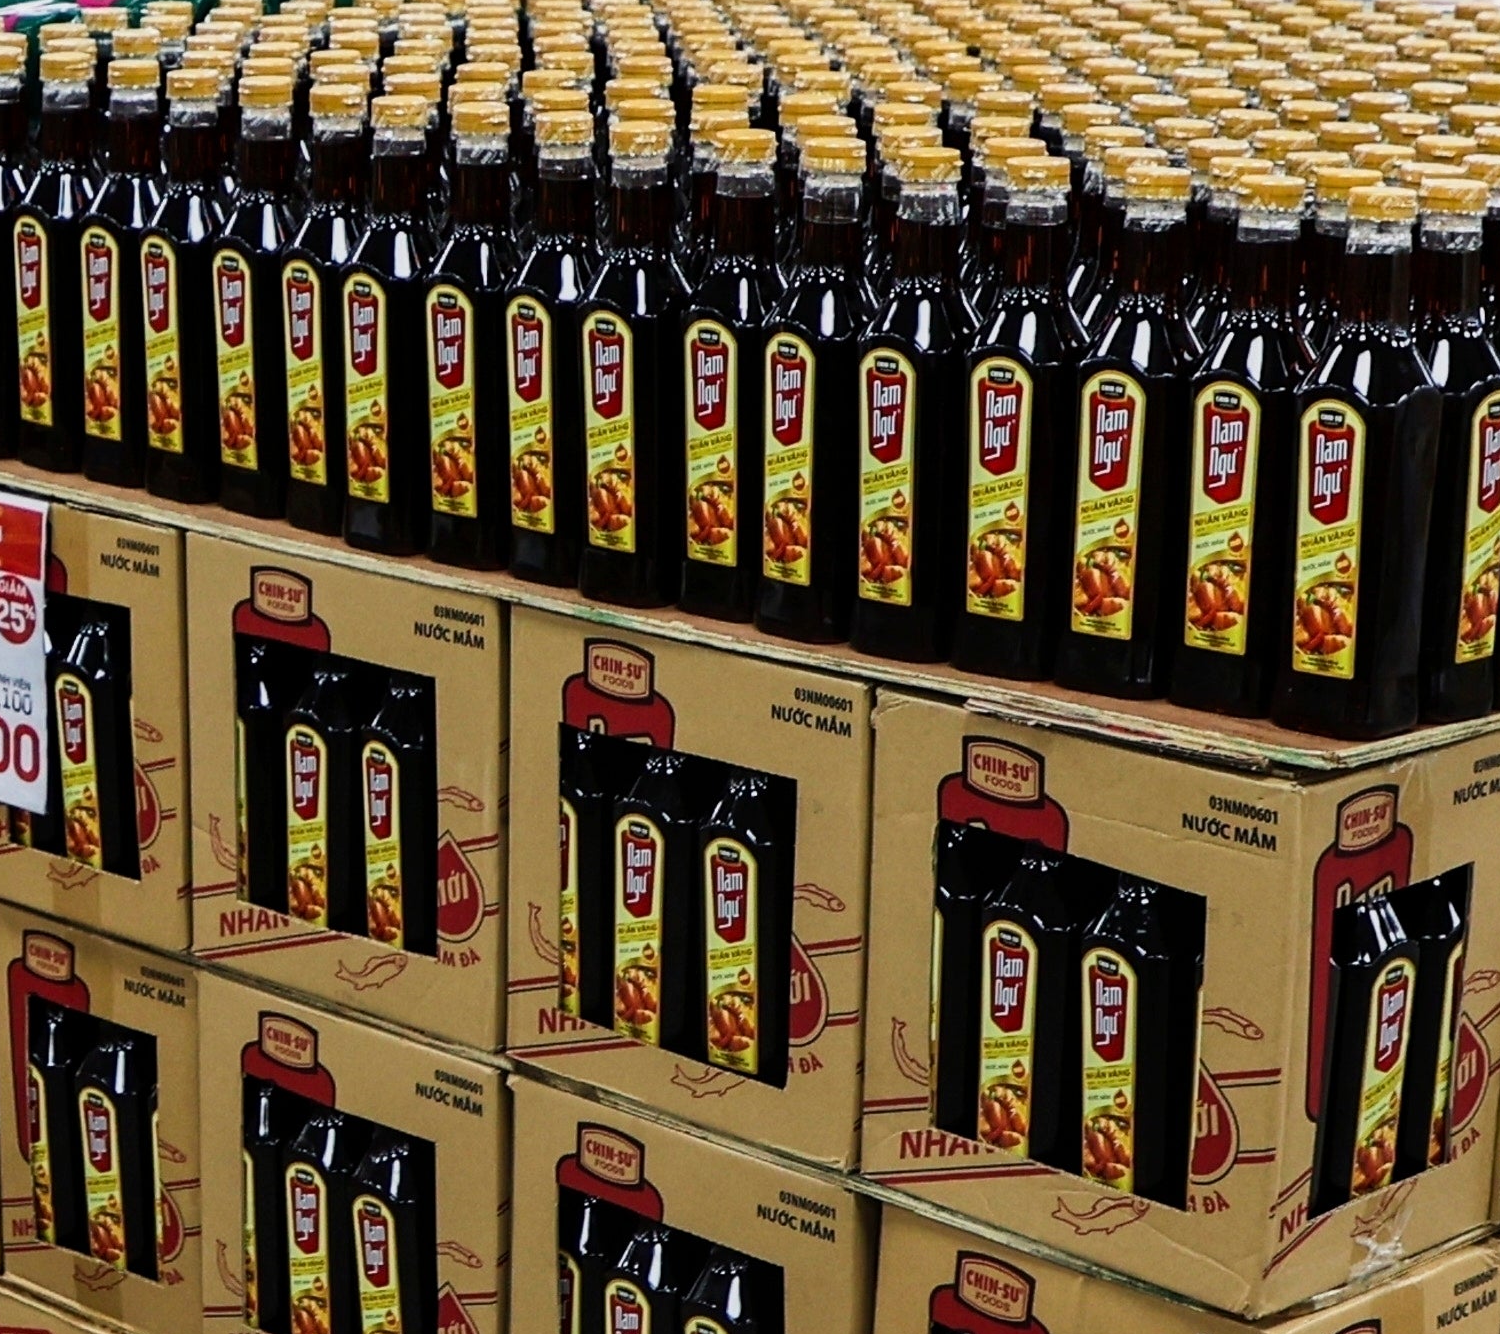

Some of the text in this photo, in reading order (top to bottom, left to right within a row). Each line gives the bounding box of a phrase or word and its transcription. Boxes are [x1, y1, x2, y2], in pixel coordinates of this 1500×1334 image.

[1211, 414, 1243, 447] Nam
[1316, 433, 1348, 467] Nam
[591, 652, 647, 680] CHIN-SU
[601, 672, 636, 691] FOODS
[793, 686, 854, 713] 03NM00601
[770, 702, 810, 729] NƯỚC
[971, 751, 1032, 786] CHIN-SU
[984, 772, 1023, 794] FOODS
[1208, 793, 1279, 827] 03NM00601
[1181, 811, 1278, 853] NƯỚC MẮM
